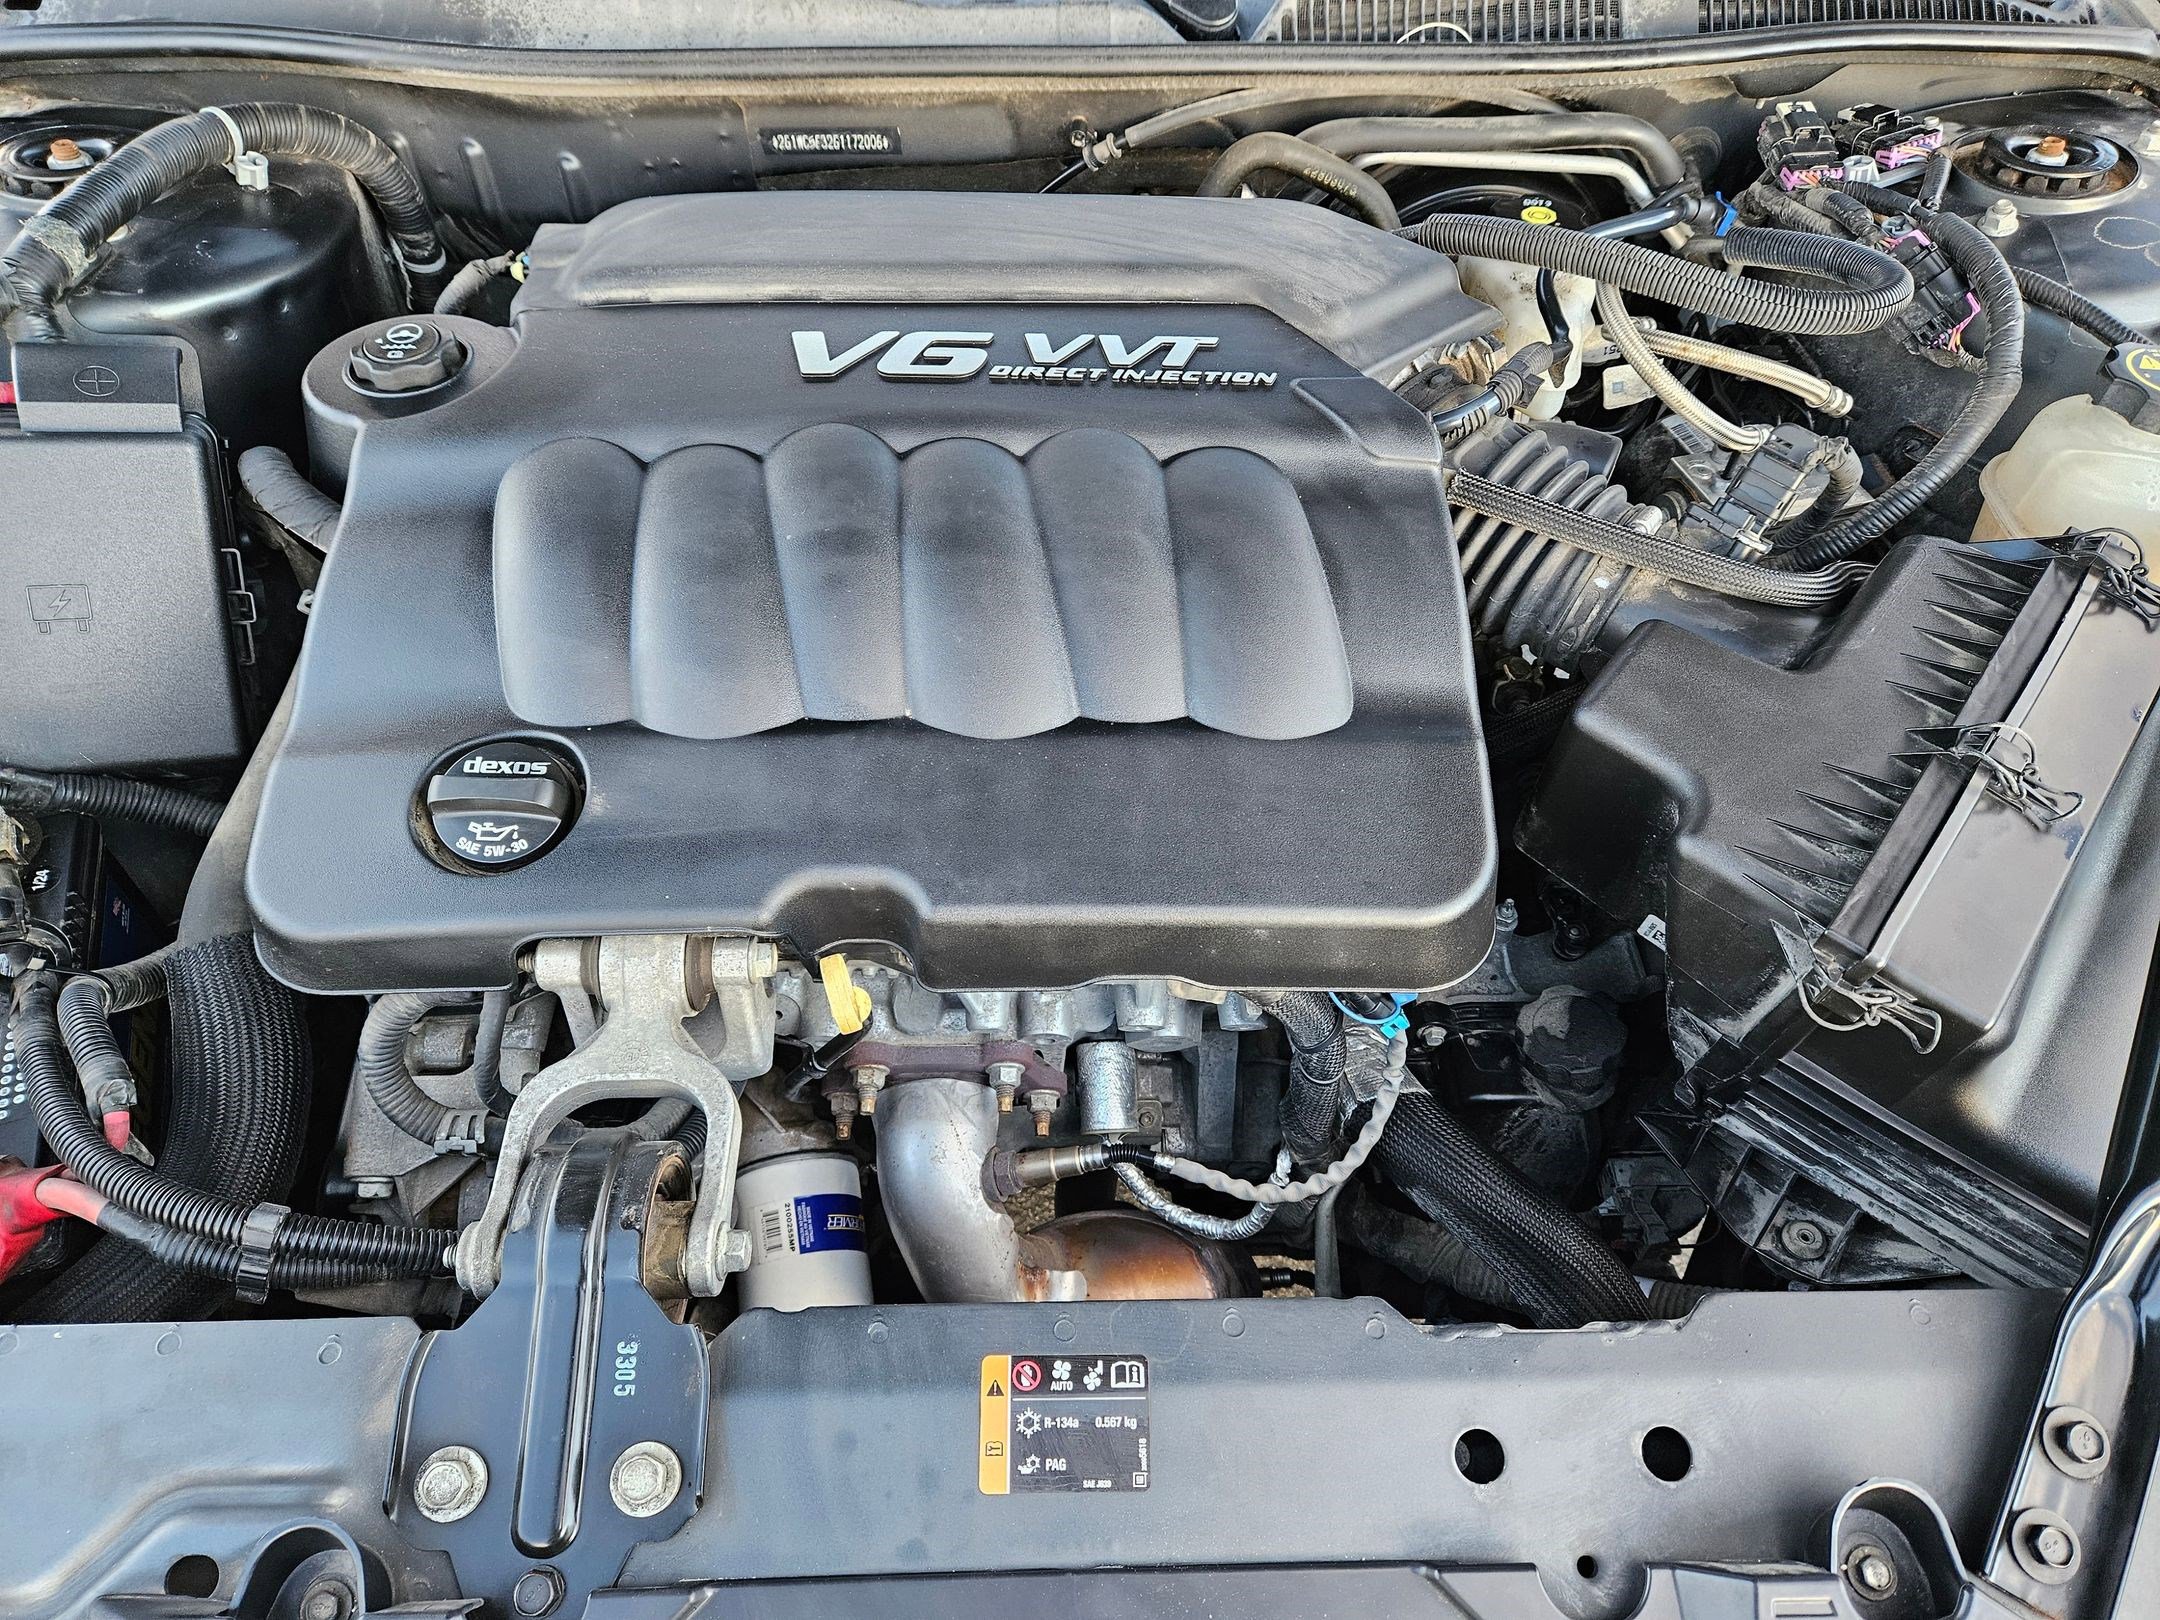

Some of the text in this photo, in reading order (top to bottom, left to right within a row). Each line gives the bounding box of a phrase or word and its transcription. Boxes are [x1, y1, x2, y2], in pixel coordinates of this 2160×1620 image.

[791, 331, 1220, 379] V6 VVT
[989, 365, 1278, 387] DIRECT INJECTION
[463, 756, 551, 775] dexos
[455, 836, 528, 857] SAE 5W-30
[31, 869, 50, 891] 1/24
[784, 1202, 796, 1252] 2100255MP
[613, 1341, 638, 1397] 3305
[1050, 1381, 1073, 1391] AUTO
[1044, 1417, 1137, 1430] R-134a 0.567 kg
[1045, 1458, 1066, 1470] PAG
[1083, 1480, 1095, 1488] SAE
